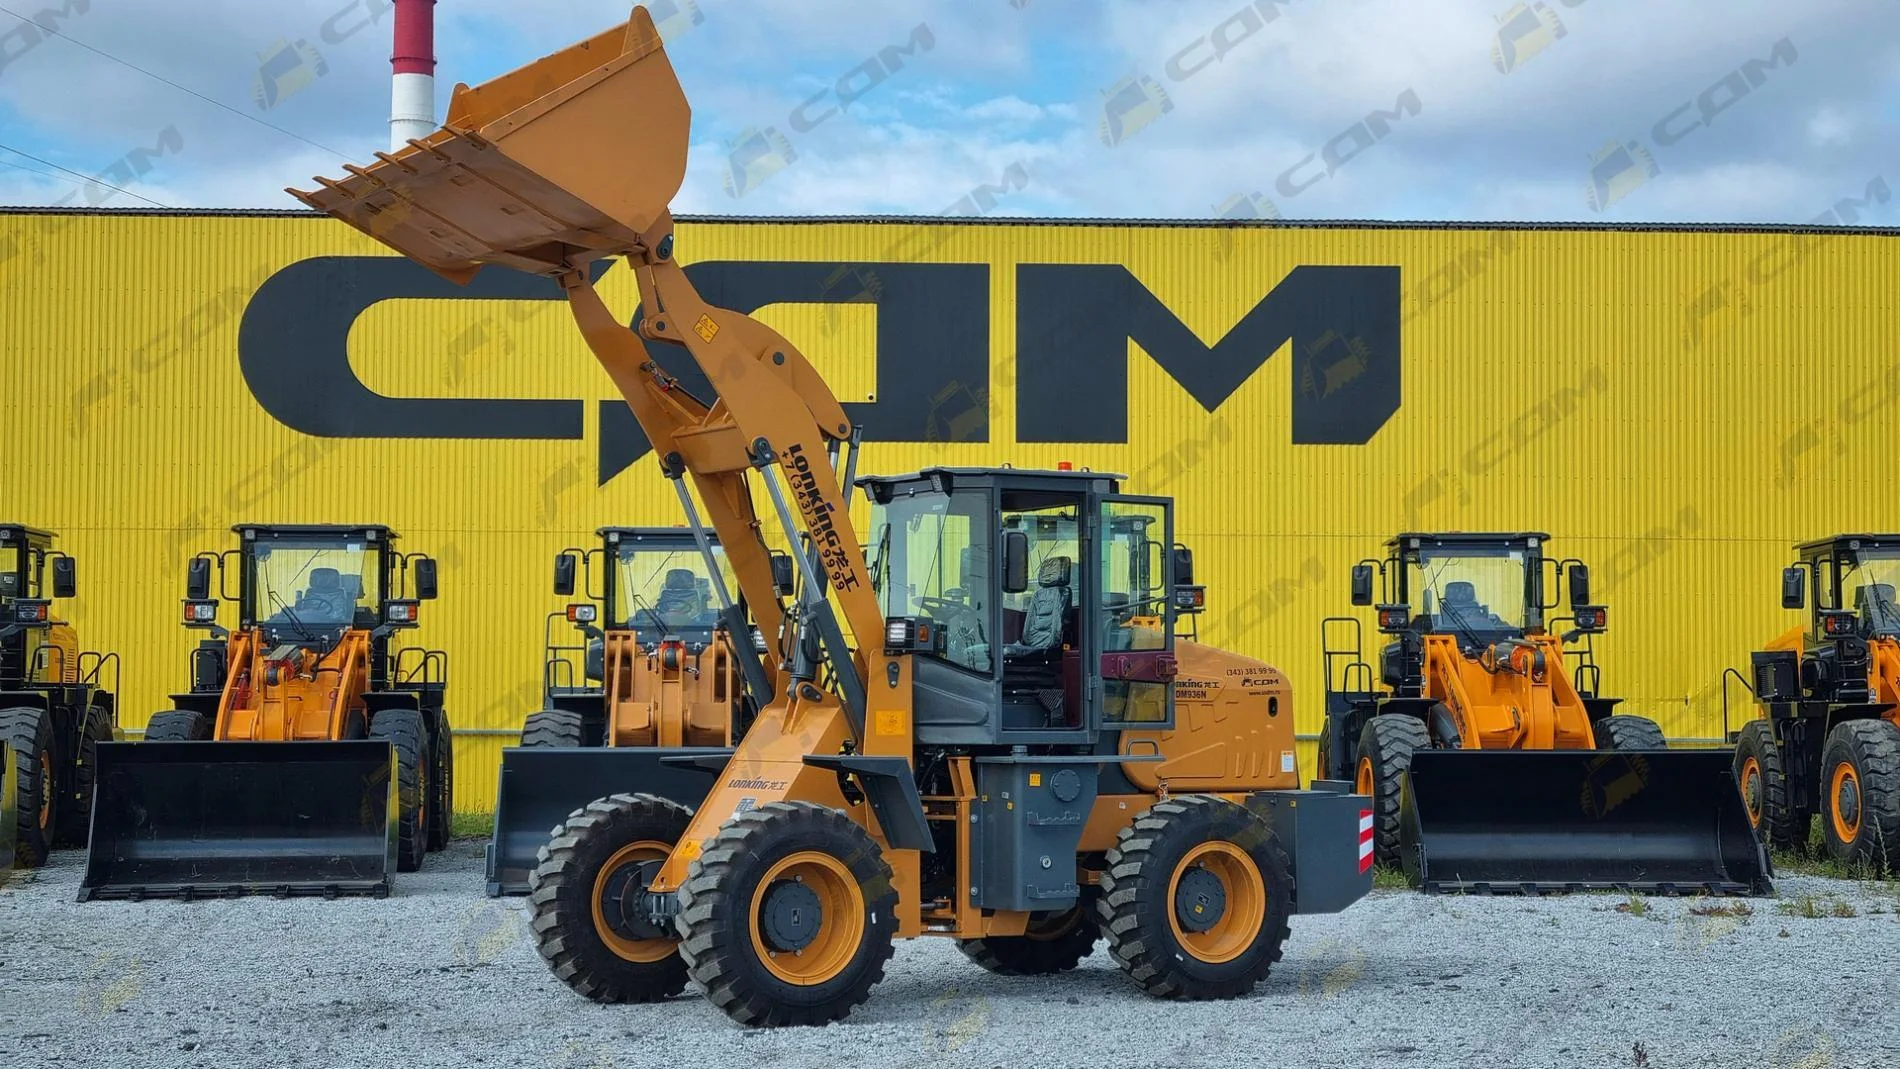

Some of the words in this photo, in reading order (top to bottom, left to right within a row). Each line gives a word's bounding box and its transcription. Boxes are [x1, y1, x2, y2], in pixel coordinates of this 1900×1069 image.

[790, 474, 813, 516] (343)
[808, 519, 826, 546] 381
[822, 548, 836, 568] 99
[831, 571, 845, 591] 99
[1226, 668, 1244, 676] (343)
[1245, 667, 1257, 675] 381
[1175, 690, 1207, 699] DM936N
